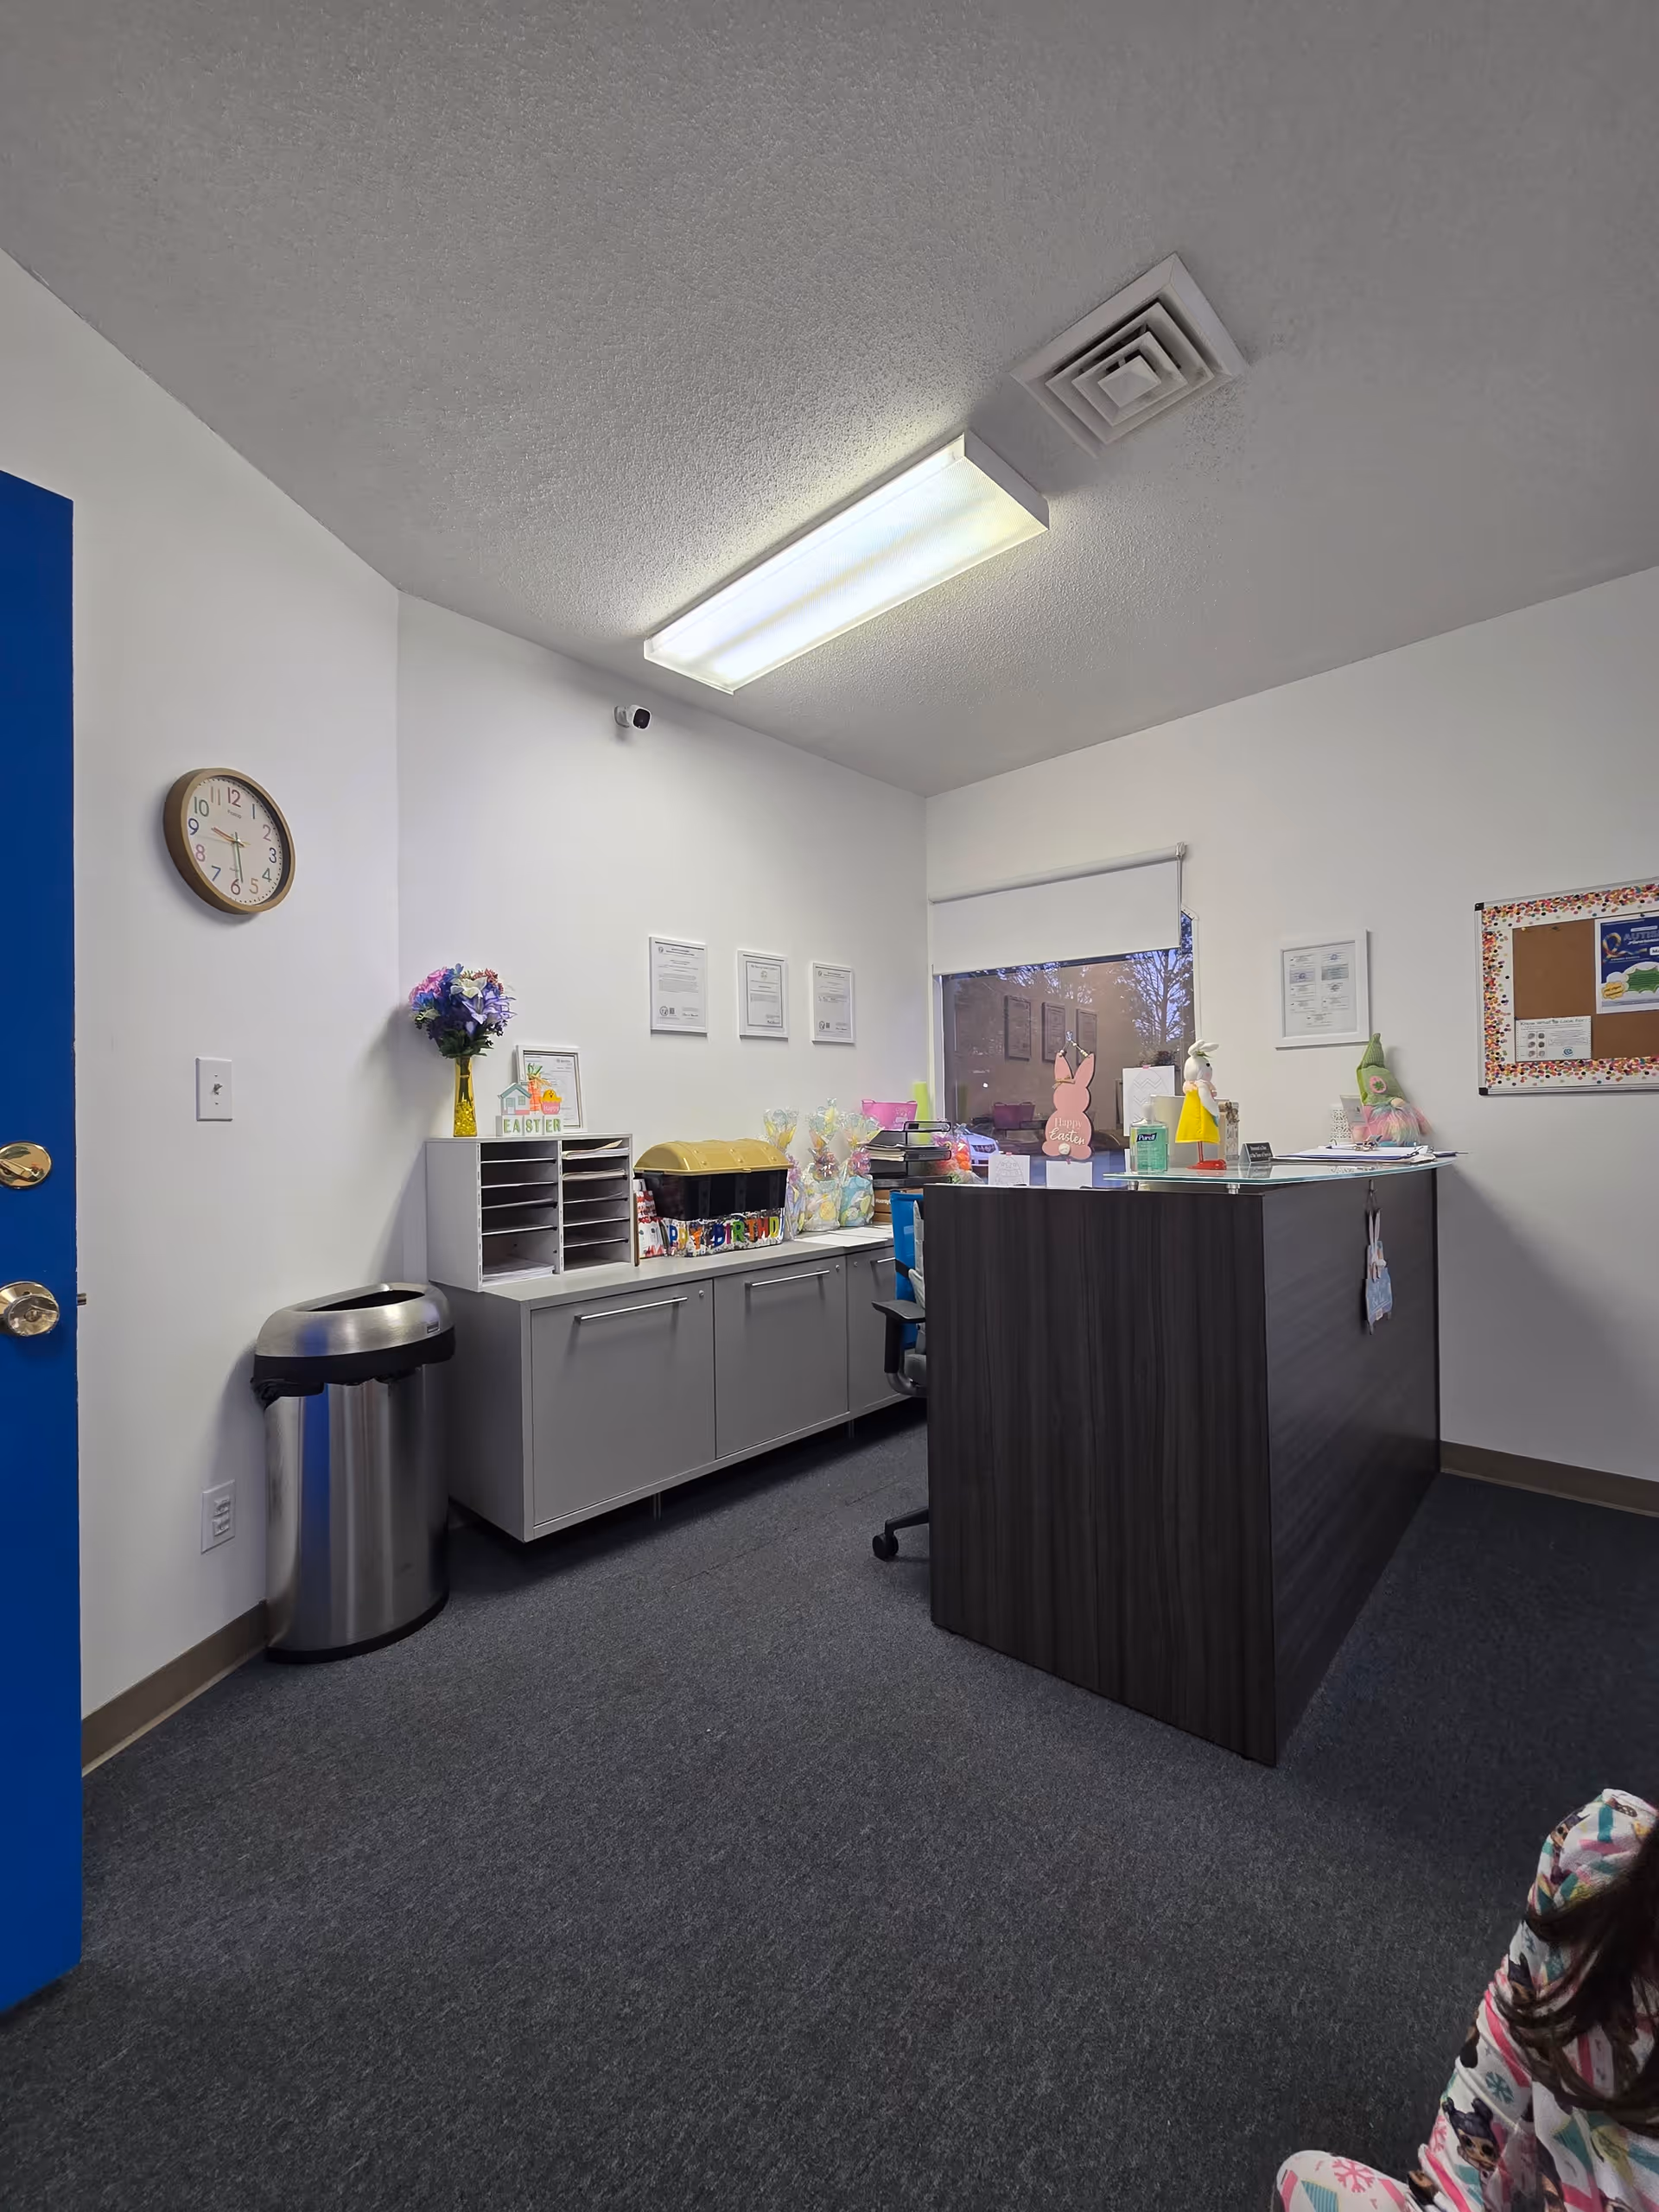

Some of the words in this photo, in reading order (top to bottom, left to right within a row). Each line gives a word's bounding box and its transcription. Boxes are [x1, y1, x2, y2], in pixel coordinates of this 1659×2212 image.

[210, 785, 221, 805] 11
[227, 786, 241, 808] 12
[194, 796, 209, 817] 10
[188, 817, 200, 836] 9
[262, 823, 271, 842] 2
[195, 843, 206, 862] 8
[269, 847, 277, 864] 3
[211, 865, 221, 881] 7
[262, 868, 272, 883] 4
[230, 878, 241, 896] 6
[249, 878, 258, 894] 5
[503, 1117, 562, 1134] EASTER
[1054, 1117, 1082, 1129] Happy
[1049, 1127, 1085, 1145] Easter
[714, 1216, 784, 1249] BIRTHD
